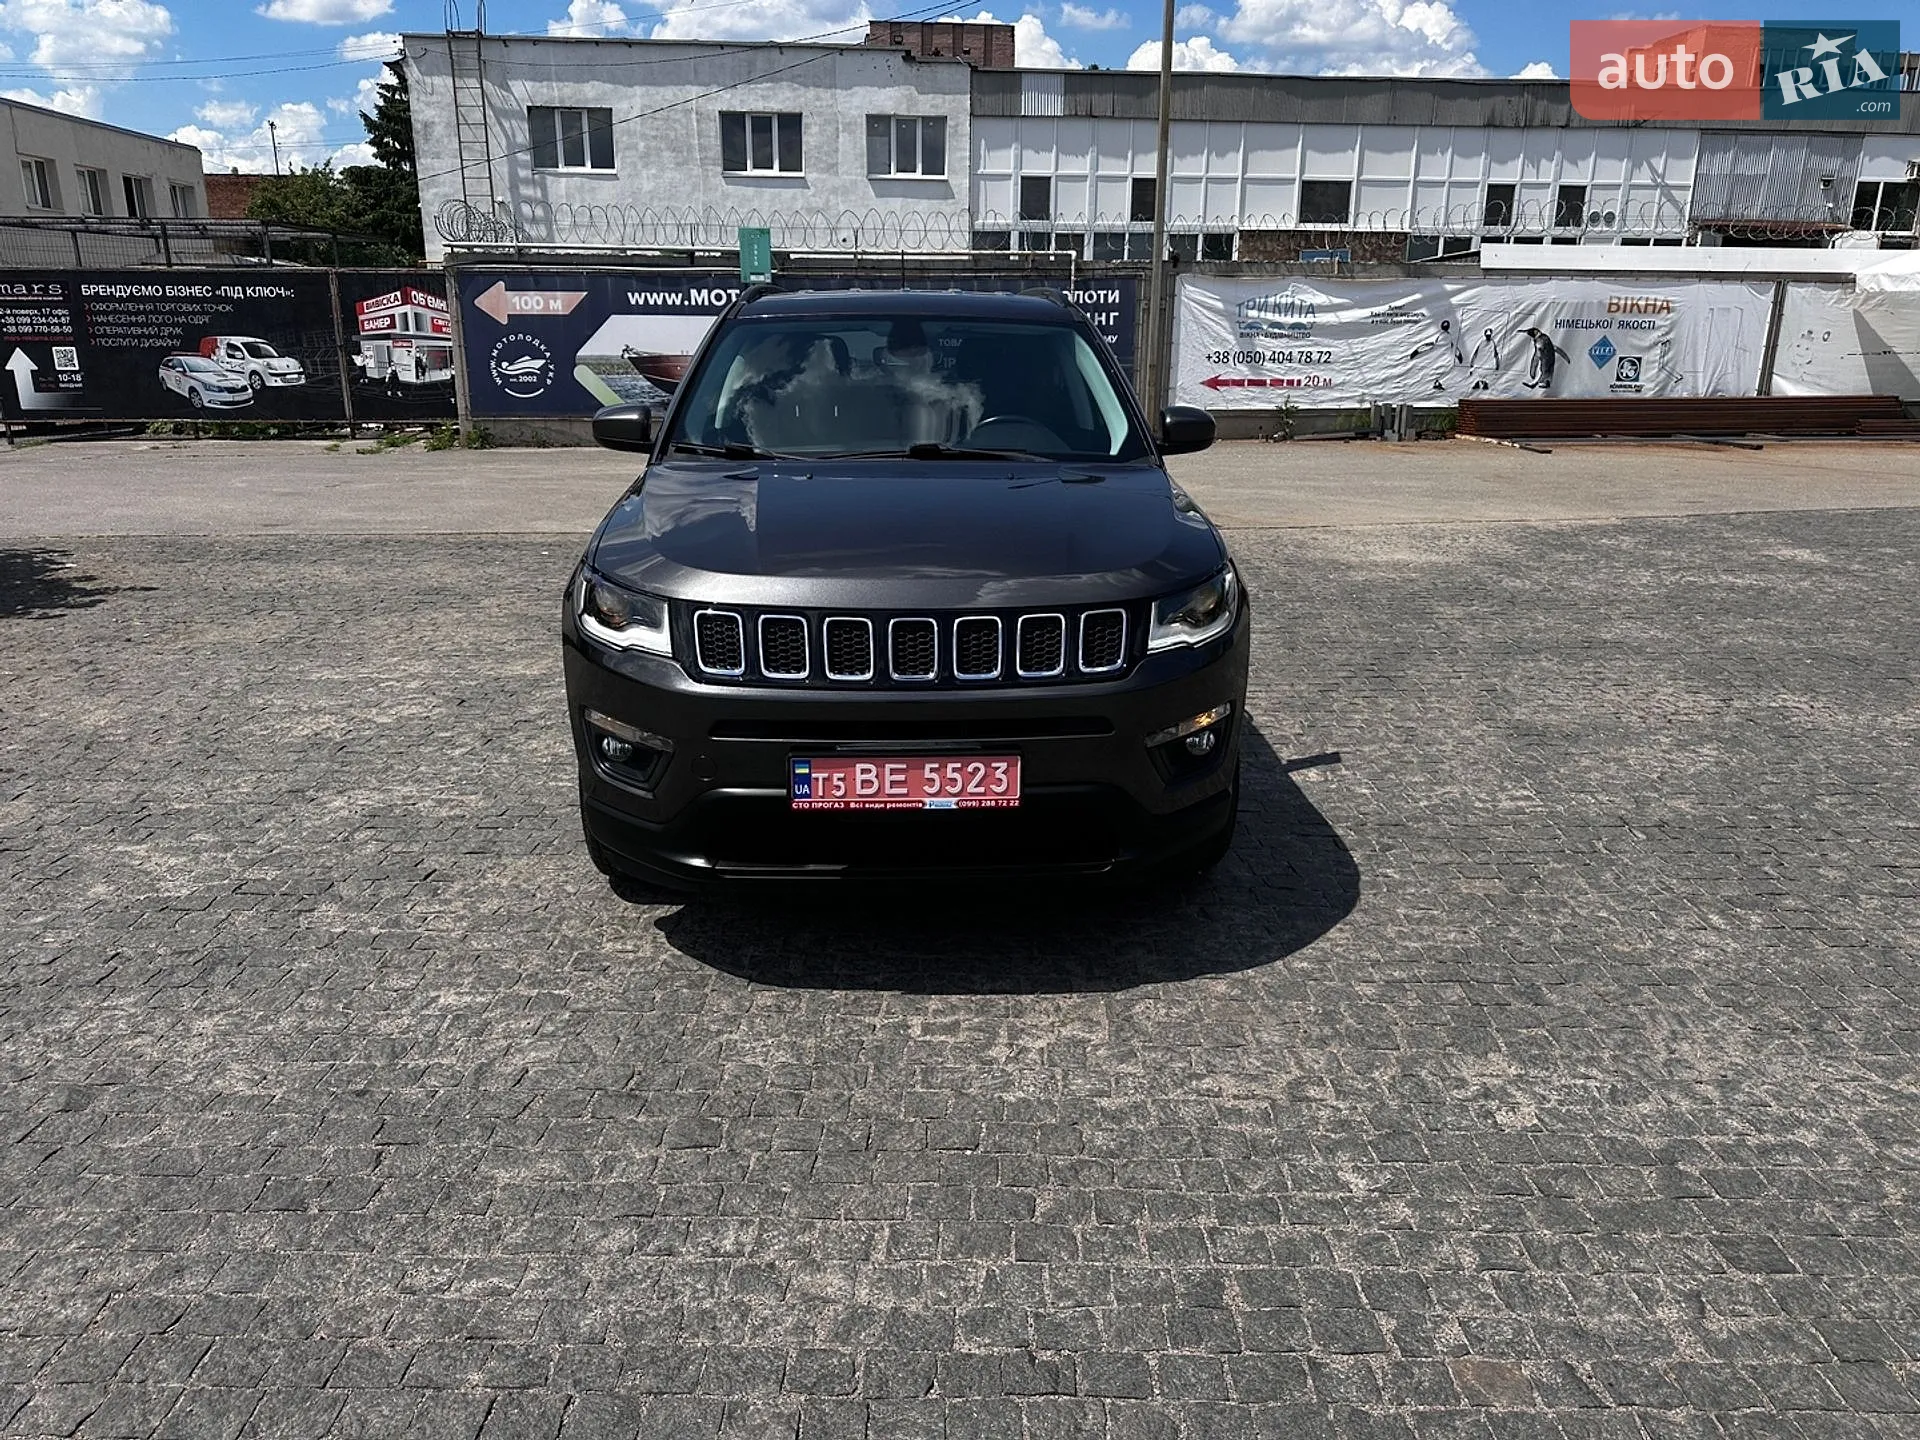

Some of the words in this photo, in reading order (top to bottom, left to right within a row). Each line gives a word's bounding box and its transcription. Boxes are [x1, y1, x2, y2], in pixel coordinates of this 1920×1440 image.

[81, 284, 163, 299] БРЕНДУЄМО
[165, 285, 212, 297] БІЗНЕС
[215, 285, 244, 299] «ПІД
[246, 286, 295, 298] КЛЮЧ»:
[91, 302, 155, 312] ОФОРМЛЕННЯ
[156, 303, 202, 312] ТОРГОВИХ
[203, 303, 234, 312] ТОЧОК
[365, 293, 400, 310] ВИВІСКА
[511, 295, 544, 310] 100
[1236, 295, 1268, 318] ТРИ
[1272, 293, 1316, 319] КИТА
[1607, 295, 1672, 314] ВІКНА
[42, 307, 50, 315] 17
[1, 316, 15, 324] +38
[92, 314, 147, 324] НАНЕСЕННЯ
[148, 314, 173, 324] ЛОГО
[174, 315, 187, 324] НА
[188, 315, 212, 325] ОДЯГ
[363, 317, 391, 330] БАНЕР
[1554, 318, 1613, 331] НІМЕЦЬКОЇ
[1617, 320, 1656, 330] ЯКОСТІ
[3, 325, 17, 333] +38
[94, 325, 159, 335] ОПЕРАТИВНИЙ
[160, 326, 184, 336] ДРУК
[96, 337, 139, 347] ПОСЛУГИ
[140, 337, 181, 348] ДИЗАЙНУ
[1205, 350, 1230, 364] +38
[1233, 350, 1265, 366] (050)
[1268, 350, 1292, 364] 404
[1297, 350, 1313, 364] 78
[1317, 350, 1332, 364] 72
[58, 373, 83, 382] 10-18
[1303, 375, 1320, 387] 20
[795, 784, 810, 795] UA
[855, 763, 908, 795] BE
[922, 762, 1008, 794] 5523
[959, 800, 980, 808] (099)
[981, 800, 996, 808] 288
[998, 800, 1007, 808] 72
[1009, 800, 1020, 808] 22
